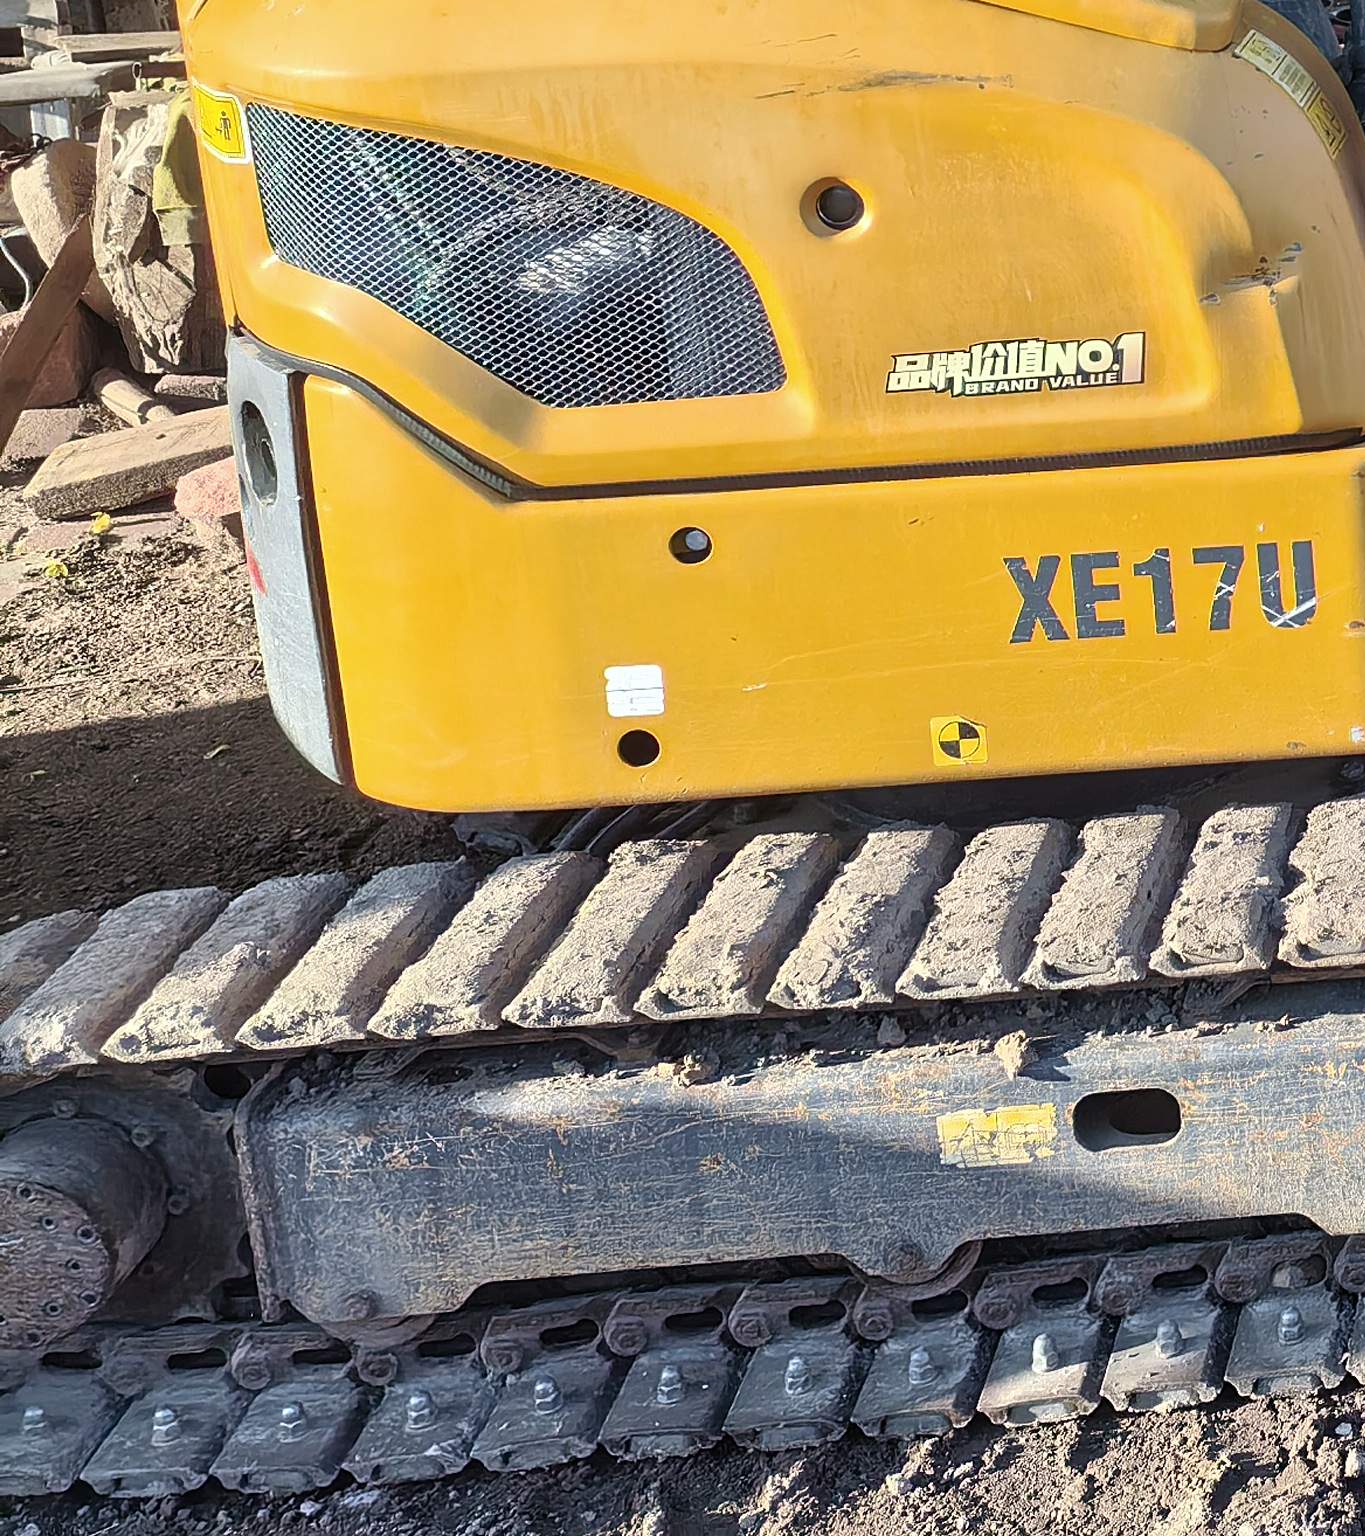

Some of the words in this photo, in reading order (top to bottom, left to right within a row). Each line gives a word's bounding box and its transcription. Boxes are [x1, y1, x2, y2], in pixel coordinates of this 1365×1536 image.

[964, 379, 1040, 396] BRAND
[1048, 372, 1119, 390] VALUE
[1002, 540, 1317, 644] XE17U
